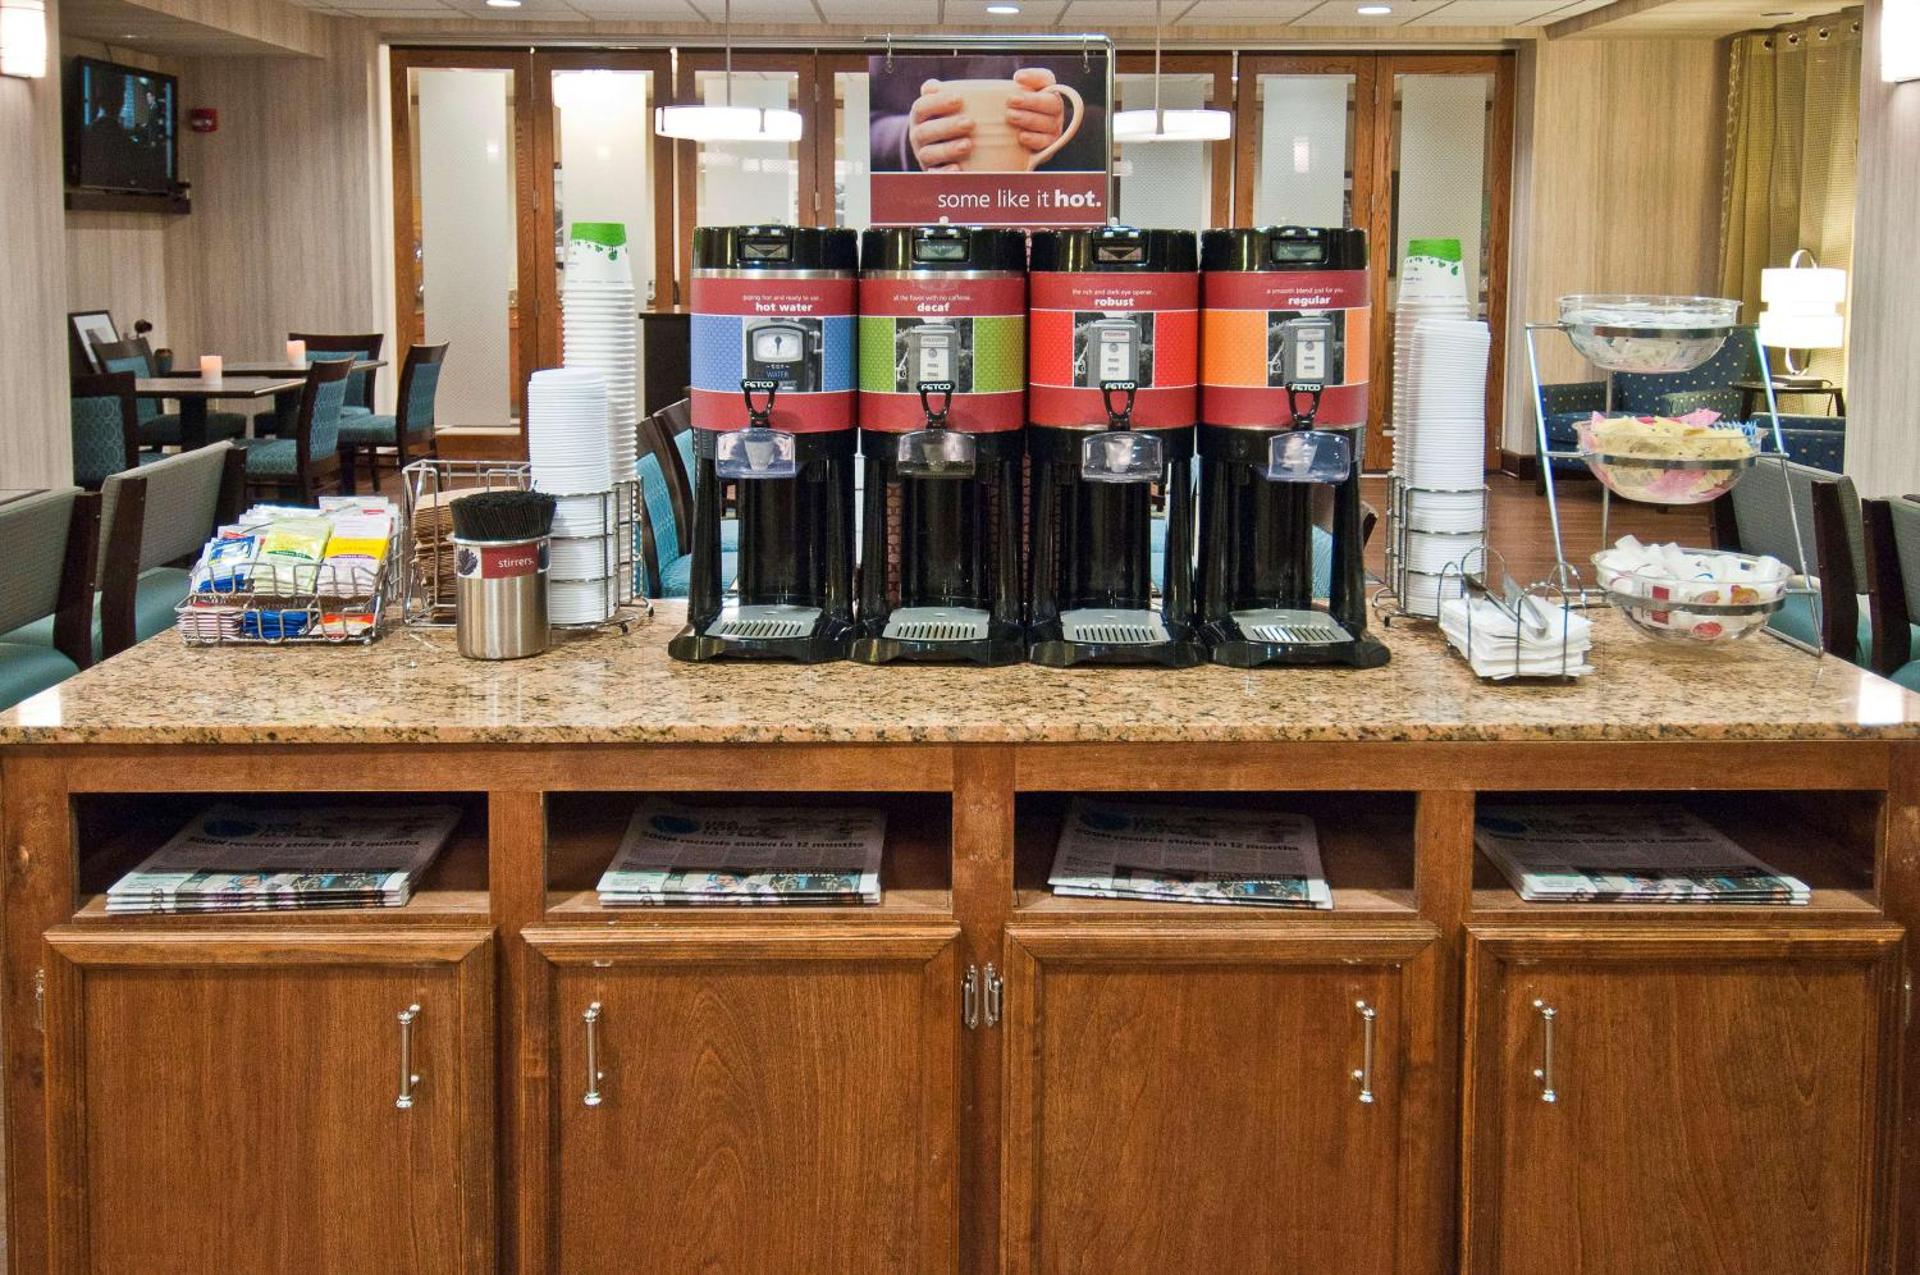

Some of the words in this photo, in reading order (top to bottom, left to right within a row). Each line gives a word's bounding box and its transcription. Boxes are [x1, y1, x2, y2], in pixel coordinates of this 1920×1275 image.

[938, 193, 990, 208] some
[997, 189, 1030, 208] like
[1038, 190, 1049, 208] it
[1055, 190, 1101, 208] hot.
[1094, 297, 1135, 306] robust
[1288, 295, 1331, 307] regular
[755, 303, 776, 312] hot
[779, 303, 813, 312] water
[917, 302, 950, 312] decaf
[921, 383, 951, 391] FETCO
[1105, 382, 1135, 390] FETCO
[1291, 383, 1321, 391] FETCO
